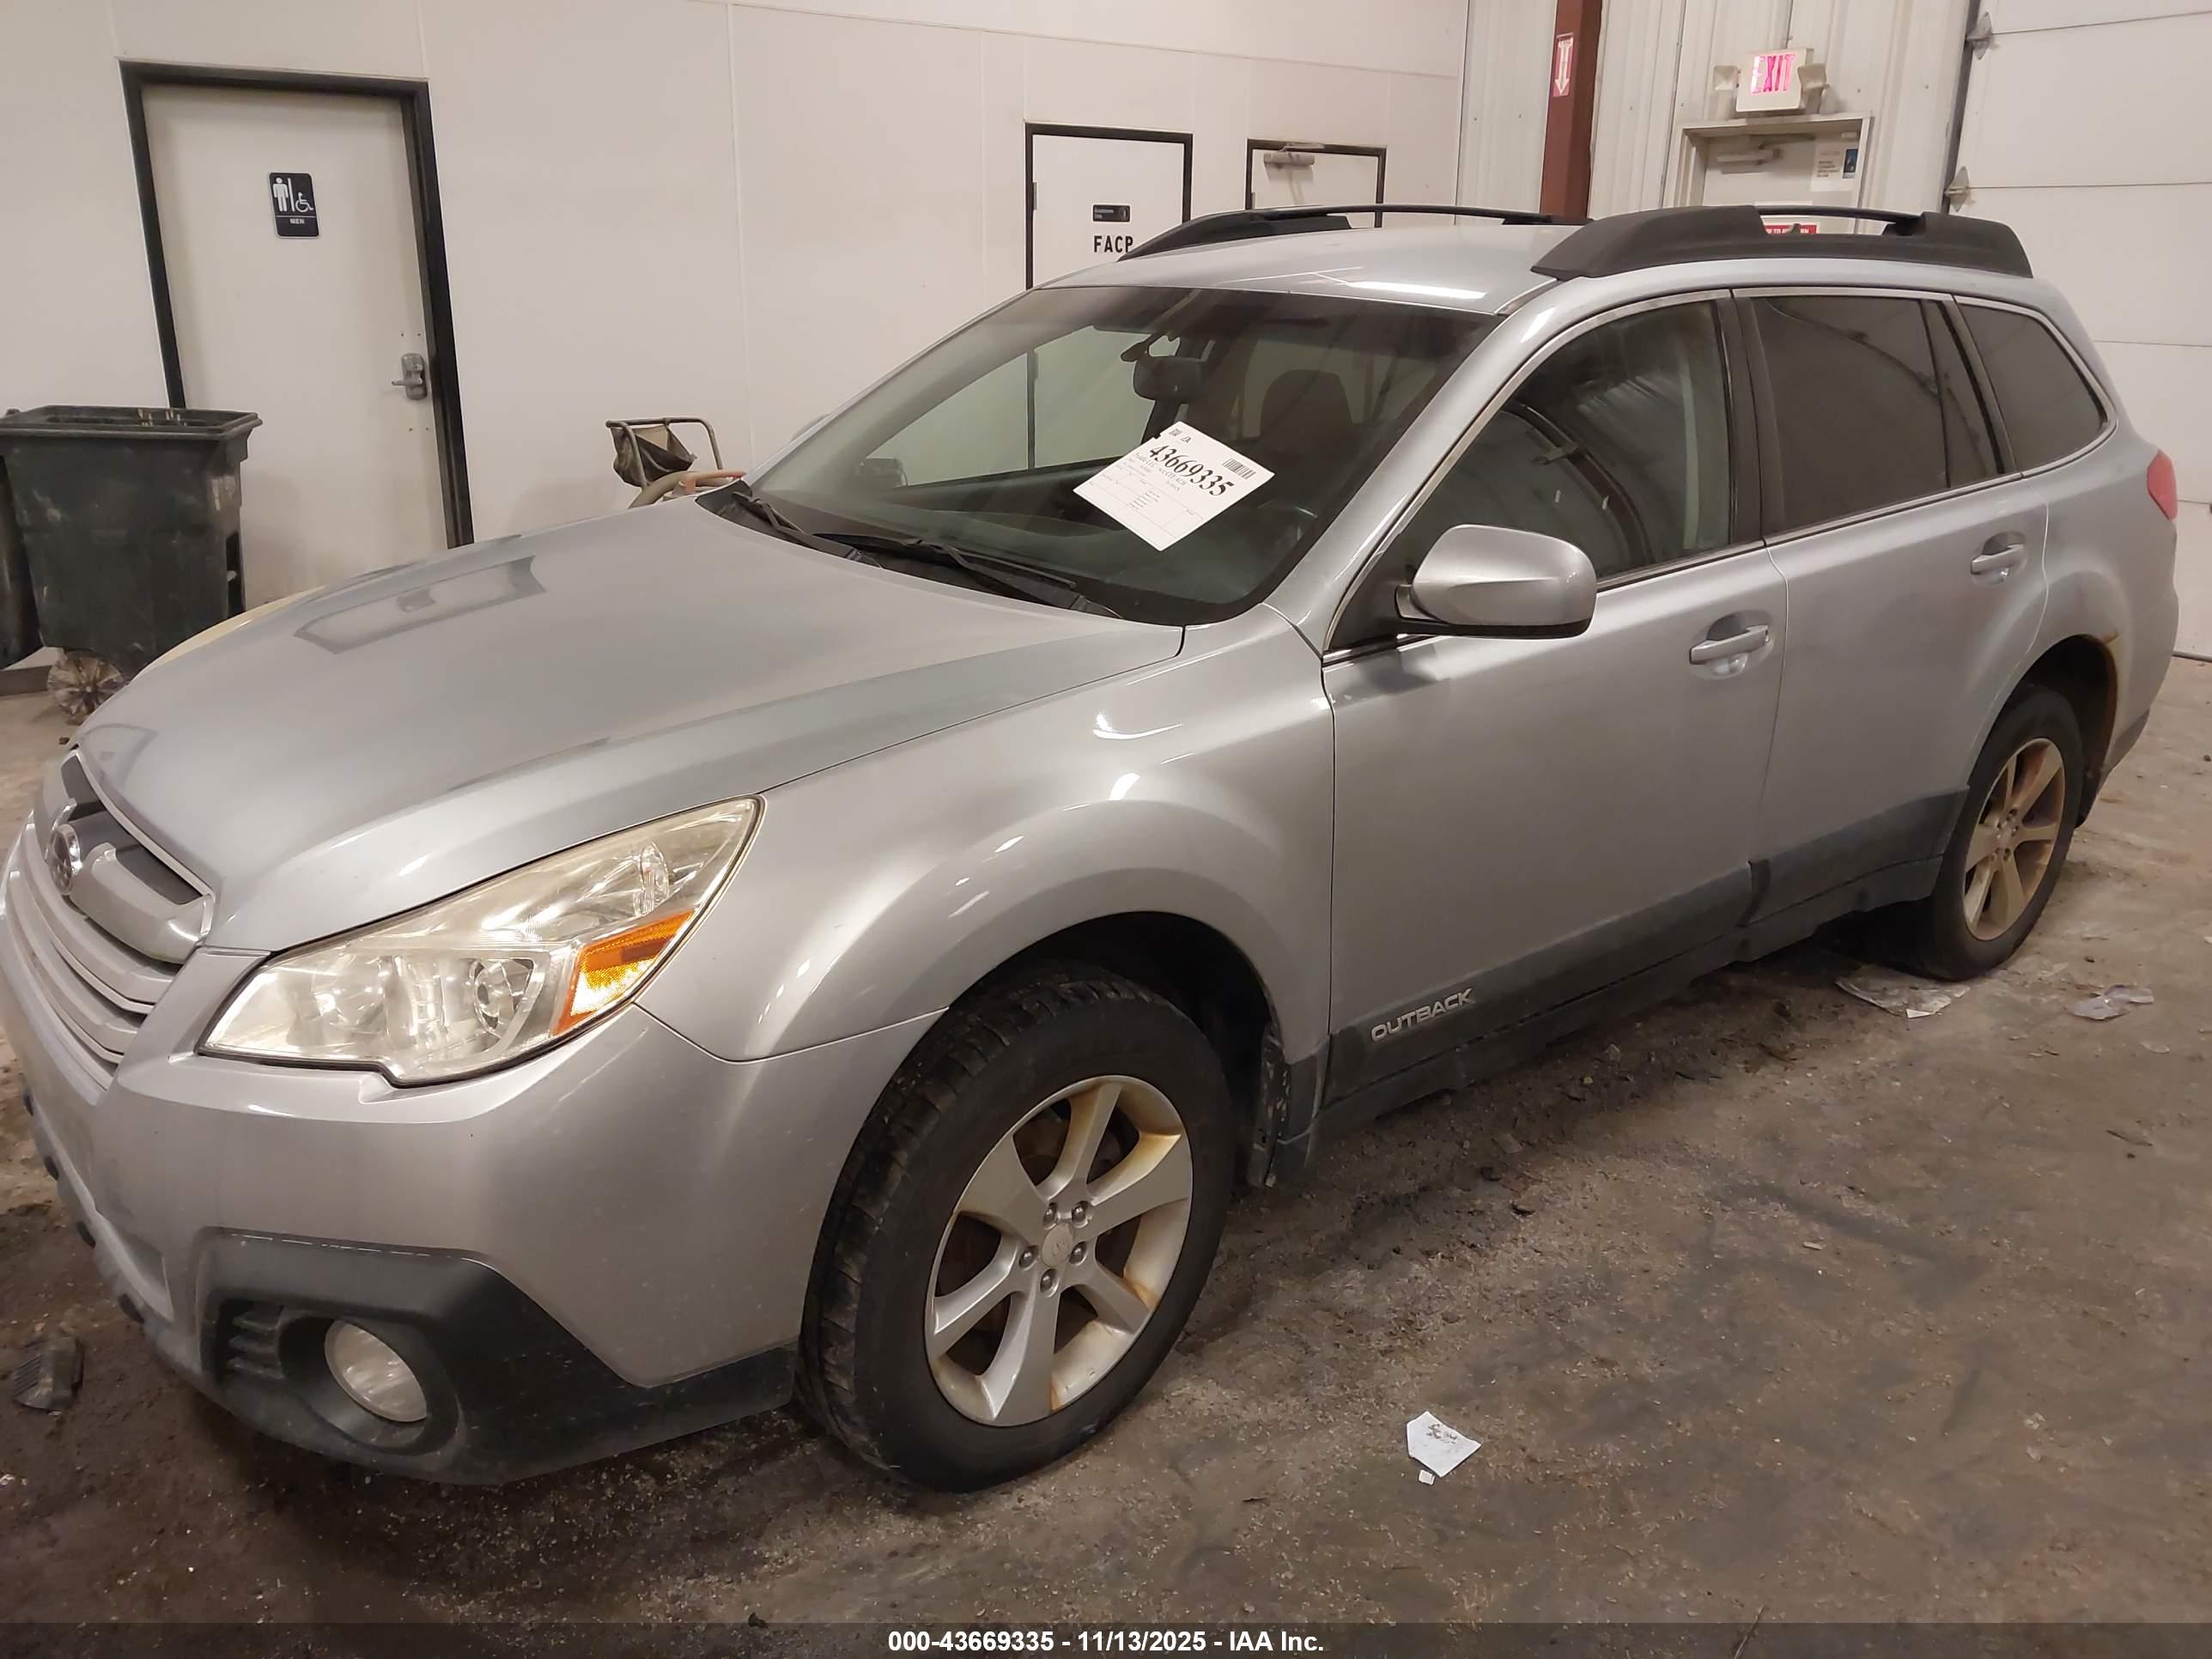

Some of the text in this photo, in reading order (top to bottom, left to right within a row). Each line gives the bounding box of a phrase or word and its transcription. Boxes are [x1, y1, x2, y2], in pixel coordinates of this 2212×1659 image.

[1752, 54, 1796, 94] EXIT
[1093, 234, 1133, 253] FACP
[1149, 445, 1235, 496] 43669335
[1371, 988, 1476, 1042] OUTBACK
